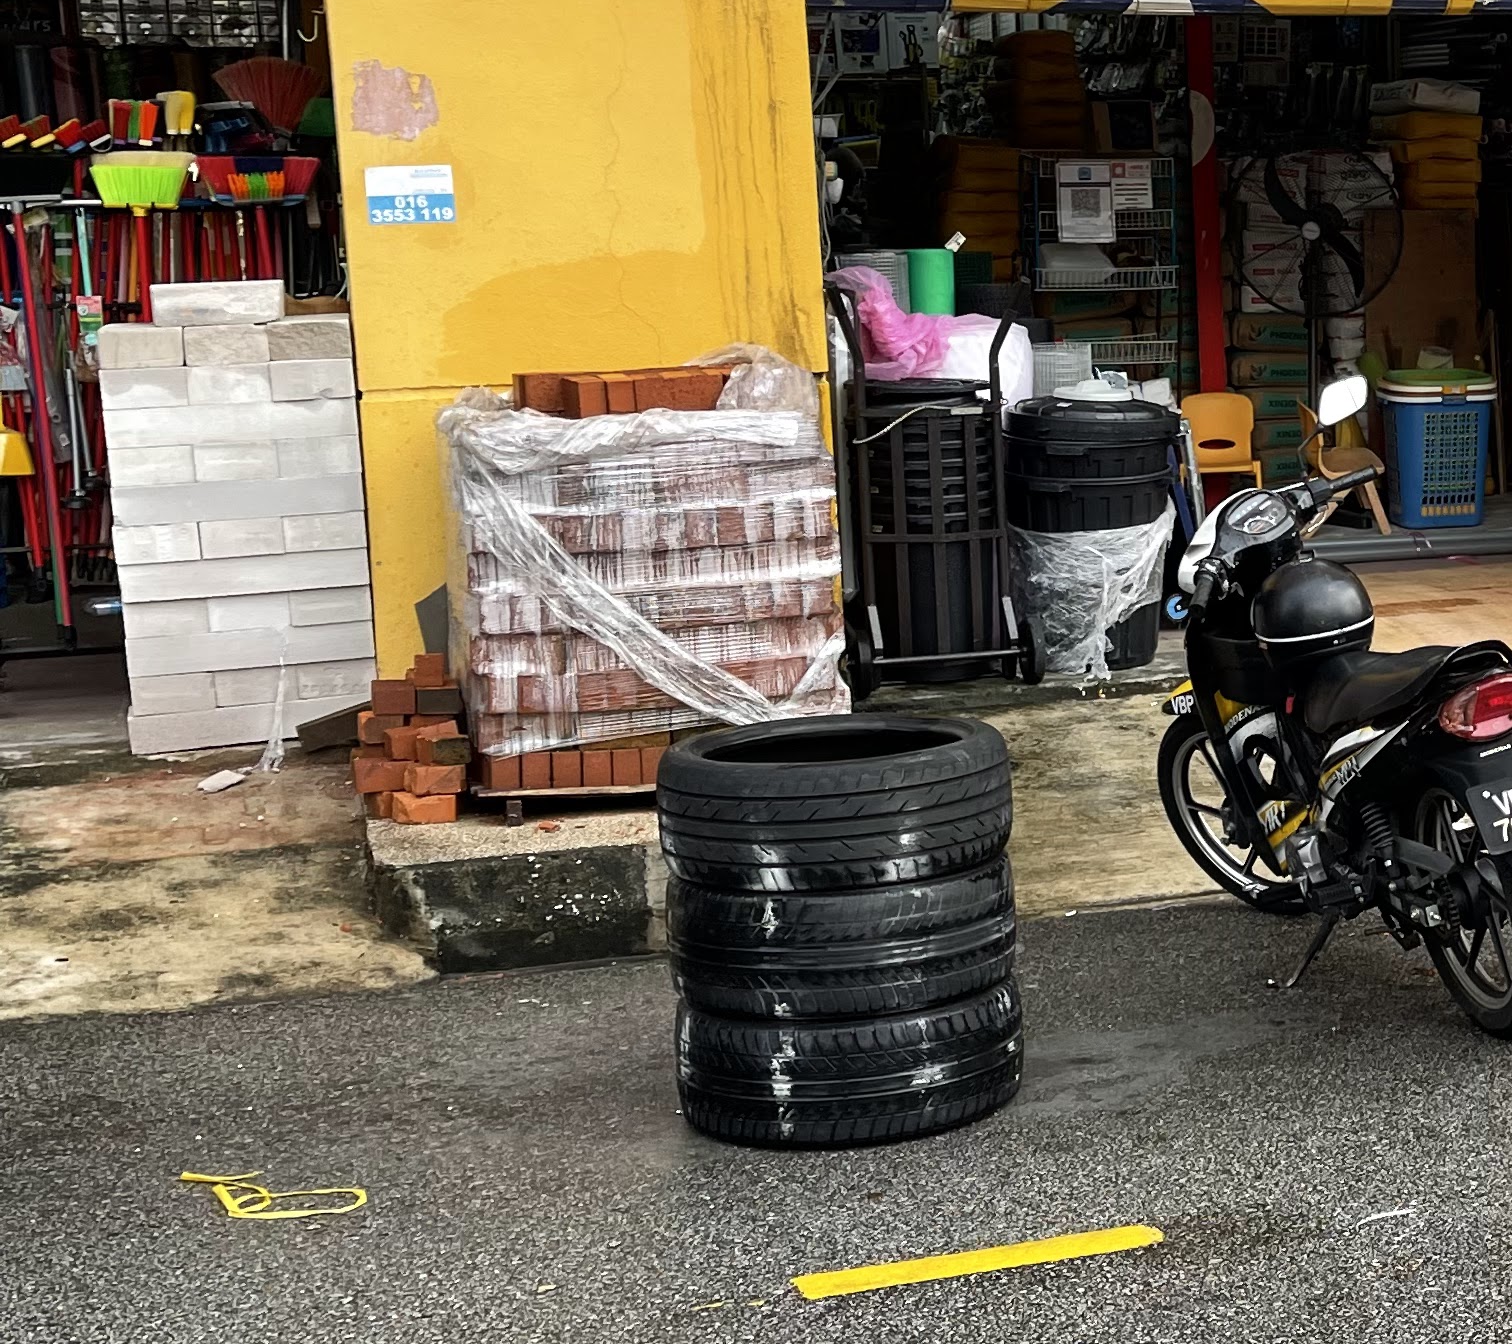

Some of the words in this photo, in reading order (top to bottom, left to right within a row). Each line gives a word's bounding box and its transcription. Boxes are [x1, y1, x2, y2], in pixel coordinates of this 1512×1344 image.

[395, 195, 428, 208] 016
[371, 208, 415, 222] 3553
[421, 207, 453, 221] 119
[1171, 694, 1194, 715] VBP
